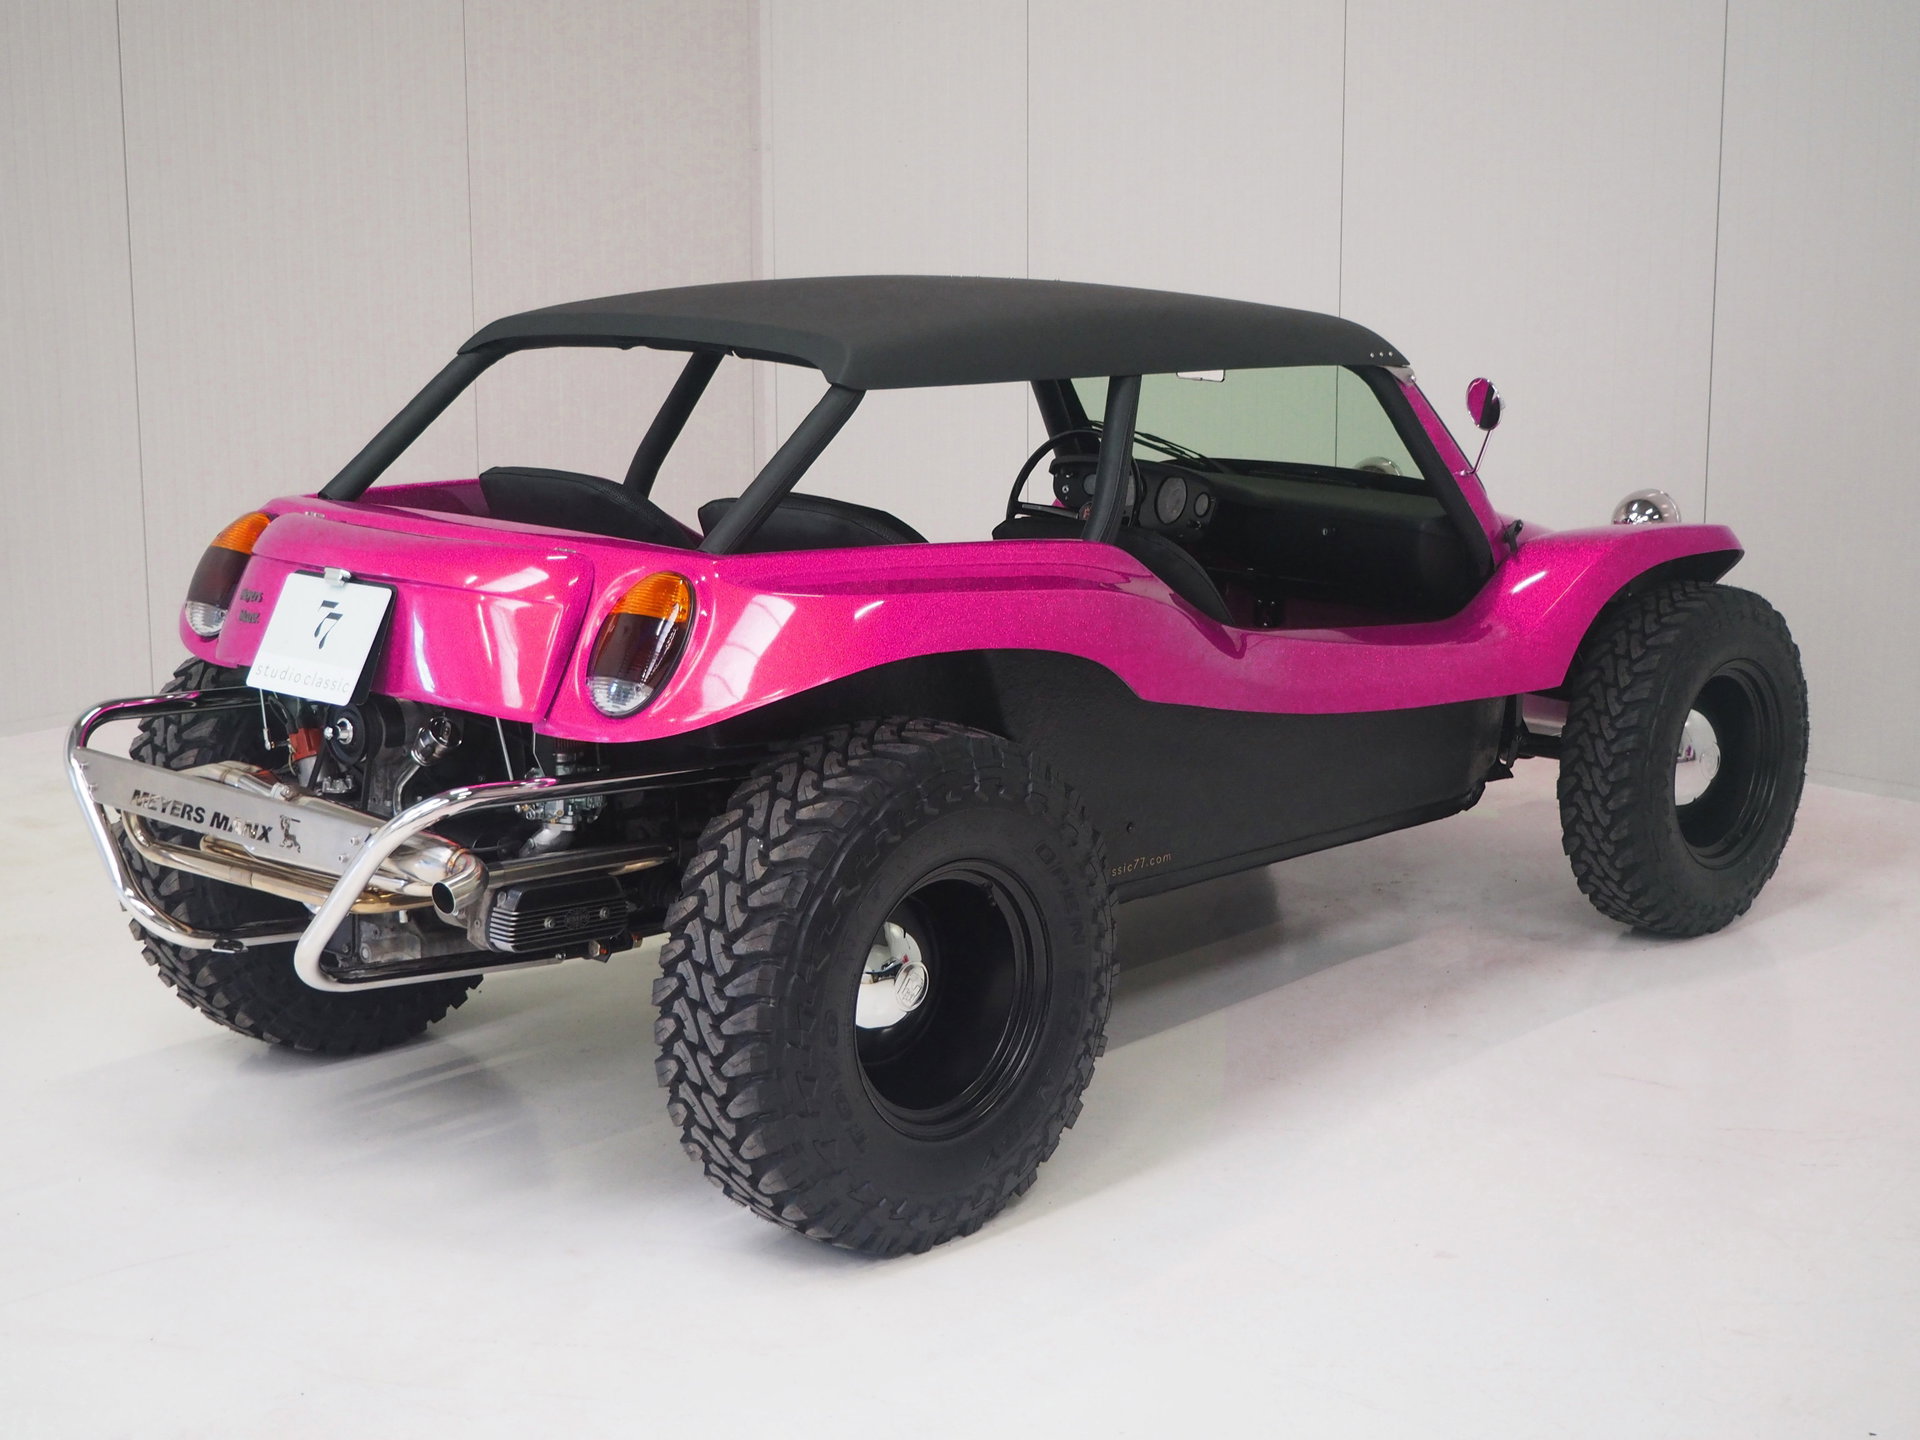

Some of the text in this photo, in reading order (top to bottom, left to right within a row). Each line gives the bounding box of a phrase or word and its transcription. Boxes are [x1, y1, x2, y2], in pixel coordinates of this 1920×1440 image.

[130, 789, 273, 843] MEYERS MANX
[1111, 852, 1172, 877] ssic77.com
